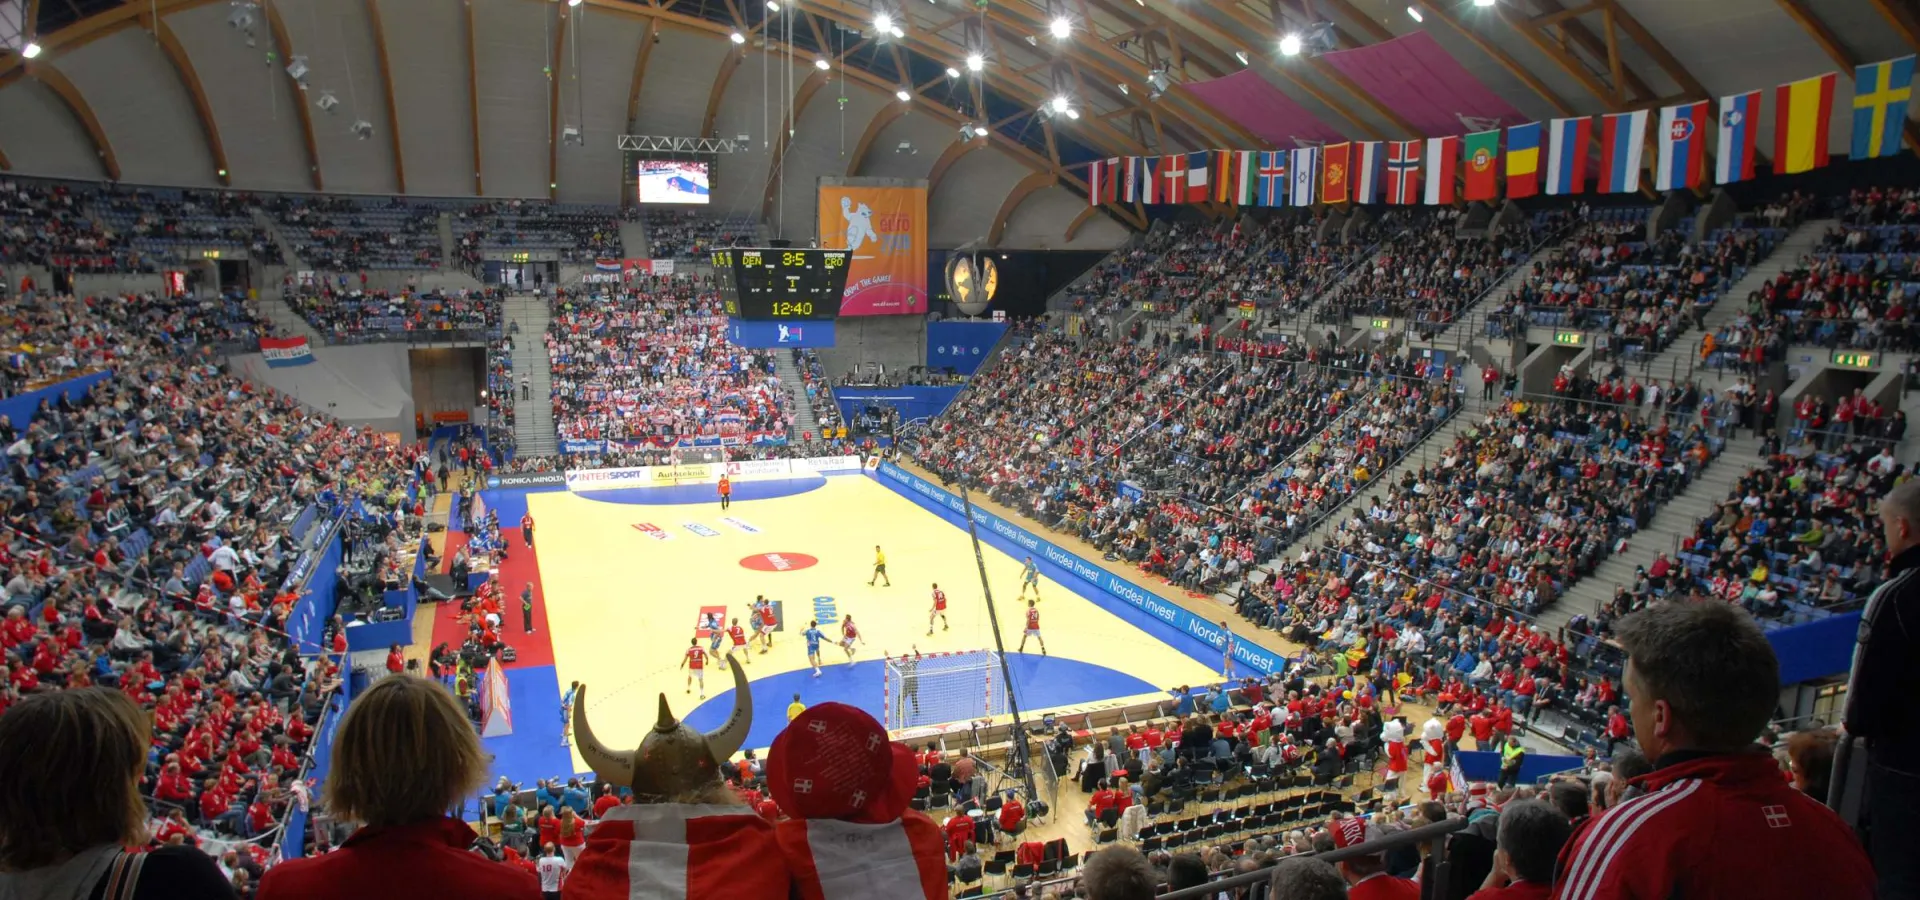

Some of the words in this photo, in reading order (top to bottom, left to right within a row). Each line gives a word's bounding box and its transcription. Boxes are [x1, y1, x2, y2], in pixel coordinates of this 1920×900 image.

[742, 256, 762, 265] DEN
[782, 253, 805, 266] 3:5
[825, 257, 843, 266] CRO
[860, 276, 872, 287] THE
[772, 302, 812, 315] 12:40
[502, 477, 531, 485] KONICA
[532, 475, 565, 483] MINOLTA
[579, 470, 641, 481] INTERSPORT
[913, 480, 931, 495] Nordea
[930, 487, 946, 502] Invest
[993, 519, 1017, 538] Nordea
[1017, 531, 1038, 549] Invest
[1045, 546, 1073, 570] Nordea
[1074, 562, 1100, 582] Invest
[1109, 577, 1143, 606] Nordea
[1145, 597, 1177, 622] Invest
[1189, 618, 1223, 646] Norde
[1234, 641, 1274, 673] Invest
[542, 864, 552, 872] 10
